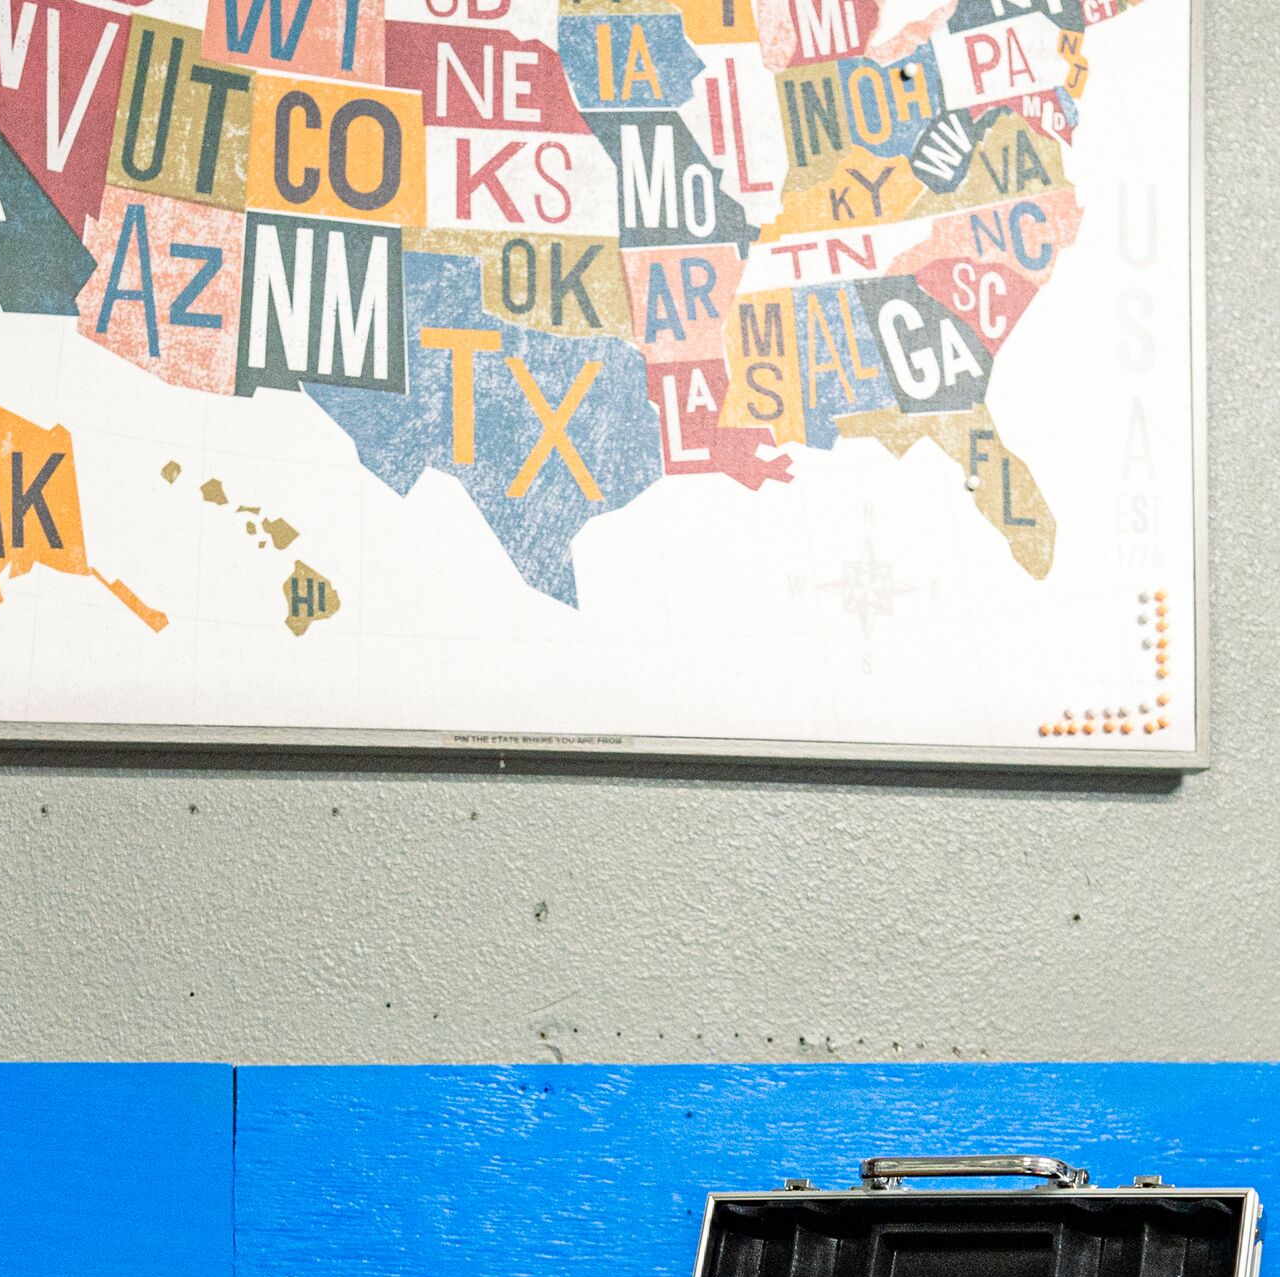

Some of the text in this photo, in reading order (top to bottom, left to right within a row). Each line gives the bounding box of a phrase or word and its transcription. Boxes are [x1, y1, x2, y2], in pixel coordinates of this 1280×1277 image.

[436, 42, 541, 122] NE
[596, 24, 663, 101] IA
[848, 63, 932, 145] OH
[965, 27, 1036, 95] PA
[120, 30, 249, 195] UT
[273, 90, 403, 211] CO
[706, 58, 773, 194] IL
[783, 77, 843, 168] IN
[914, 112, 974, 182] WV
[456, 137, 572, 224] KS
[829, 166, 894, 221] KY
[980, 129, 1052, 195] VA
[771, 234, 877, 280] TN
[971, 202, 1053, 271] NC
[247, 224, 388, 380] NM
[501, 238, 605, 328] OK
[644, 256, 719, 344] AR
[952, 262, 1007, 340] SC
[808, 288, 879, 409] AL
[877, 298, 985, 400] GA
[420, 326, 605, 501] TX
[662, 368, 717, 463] LA
[291, 577, 326, 618] HI
